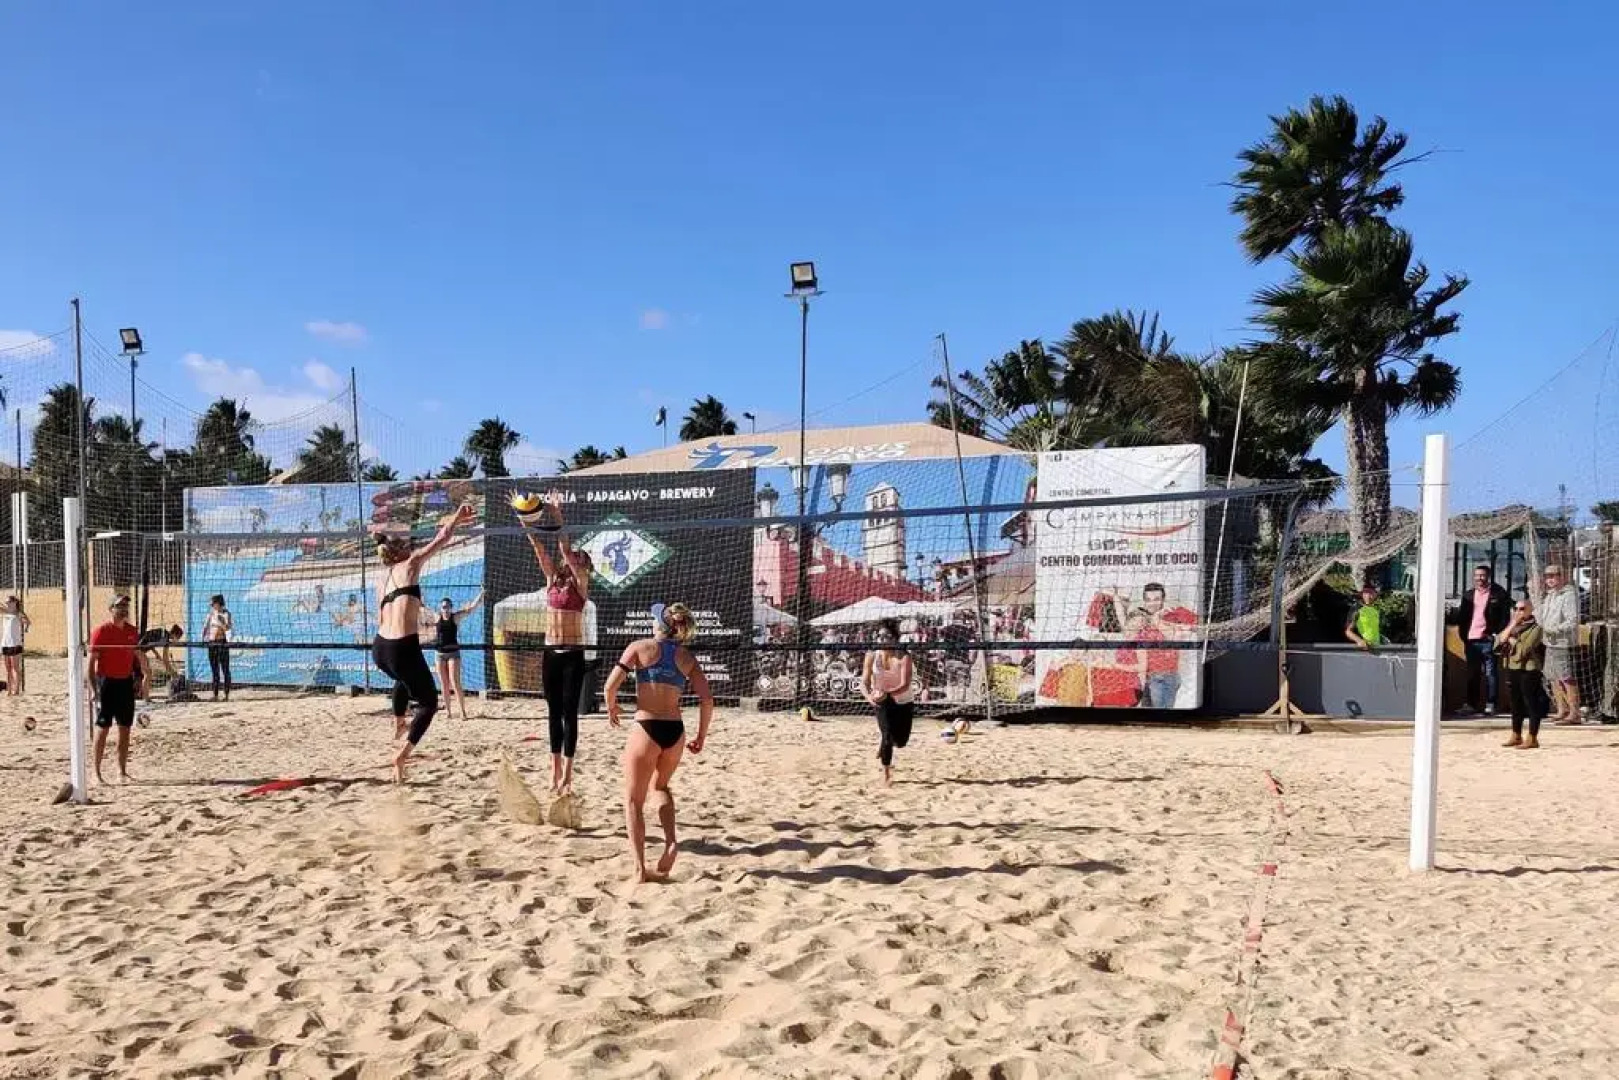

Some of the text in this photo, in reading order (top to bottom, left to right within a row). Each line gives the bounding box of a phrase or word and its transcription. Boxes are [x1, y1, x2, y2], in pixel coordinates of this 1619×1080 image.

[587, 489, 649, 502] PAPAGAYO
[660, 486, 716, 499] BREWERY
[1041, 551, 1198, 568] CENTRO COMERCIAL Y DE OCIO
